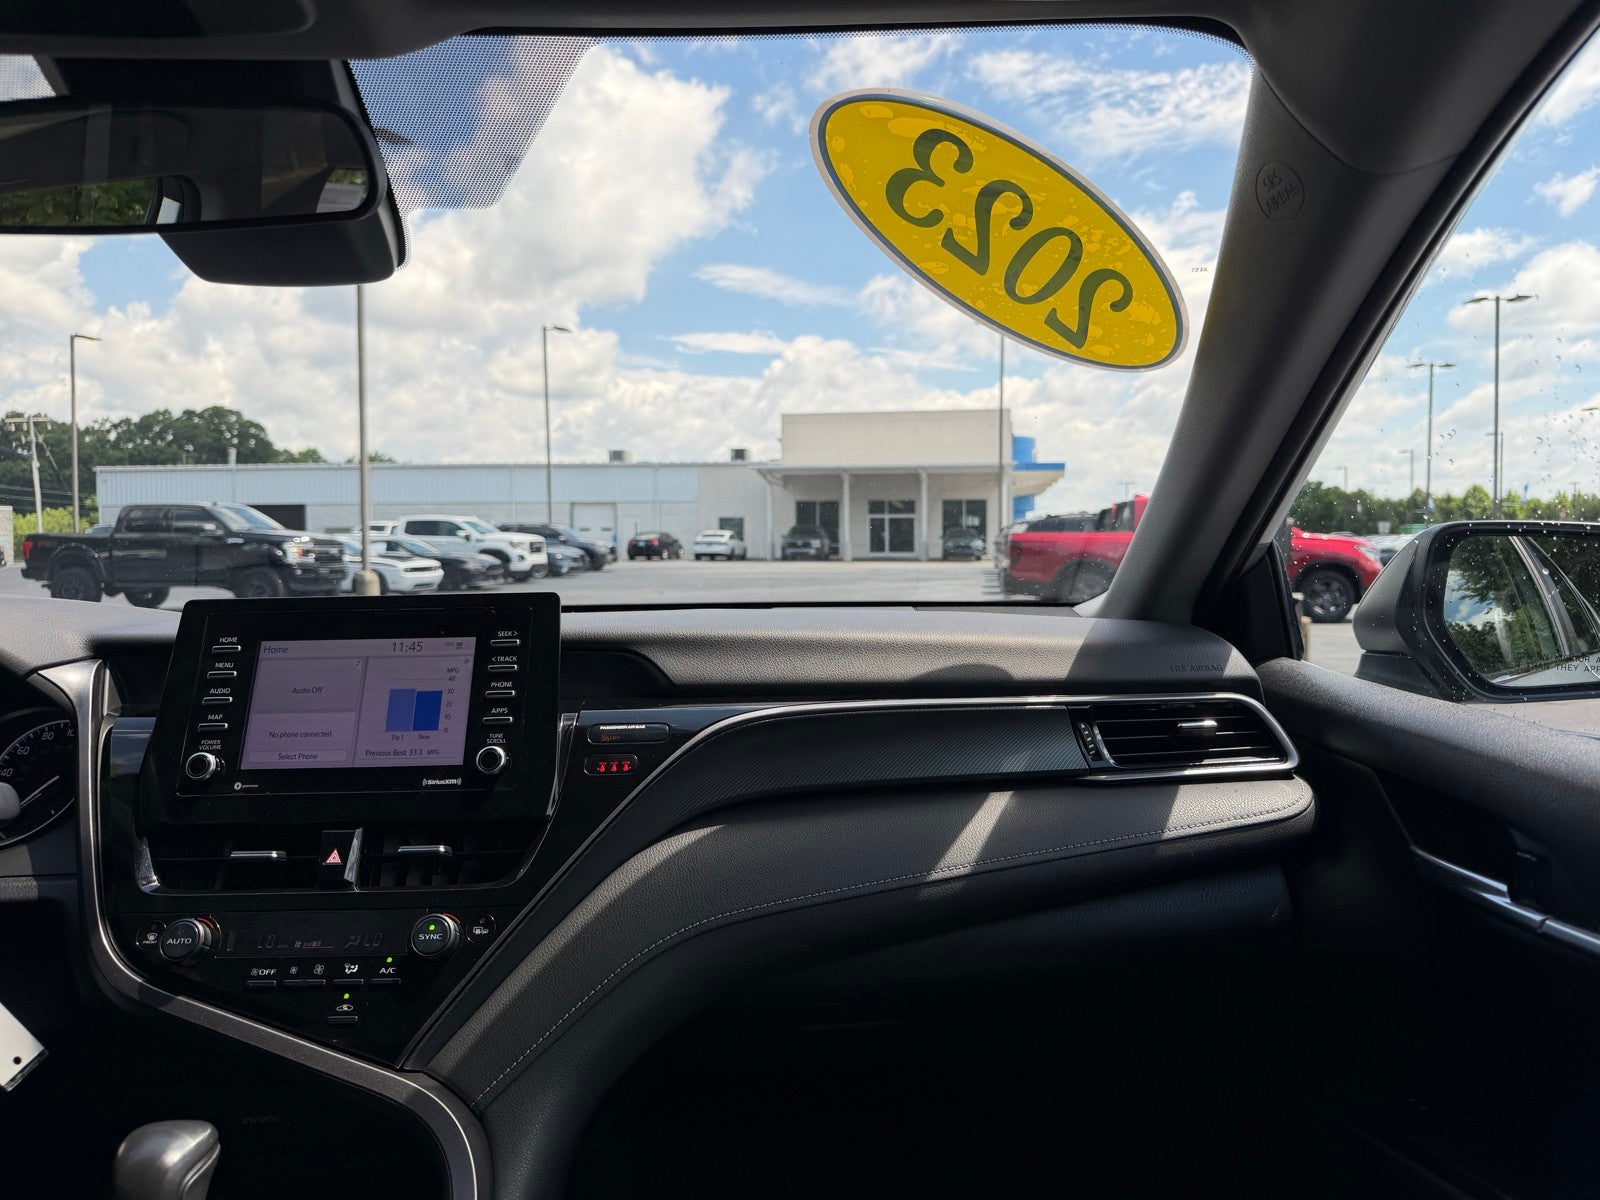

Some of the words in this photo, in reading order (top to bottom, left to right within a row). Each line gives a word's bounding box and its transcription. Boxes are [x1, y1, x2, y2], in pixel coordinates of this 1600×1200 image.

[263, 645, 289, 654] Home
[392, 641, 424, 652] 11:45
[1555, 663, 1579, 671] THEY
[292, 686, 310, 694] Audio
[311, 686, 324, 694] Off
[42, 731, 54, 740] 80
[279, 730, 299, 740] phone
[17, 746, 30, 755] 60
[365, 749, 391, 757] Previous
[278, 753, 297, 761] Select
[1, 768, 13, 777] 40
[166, 937, 192, 945] AUTO
[258, 968, 277, 976] OFF
[379, 967, 397, 975] A/C
